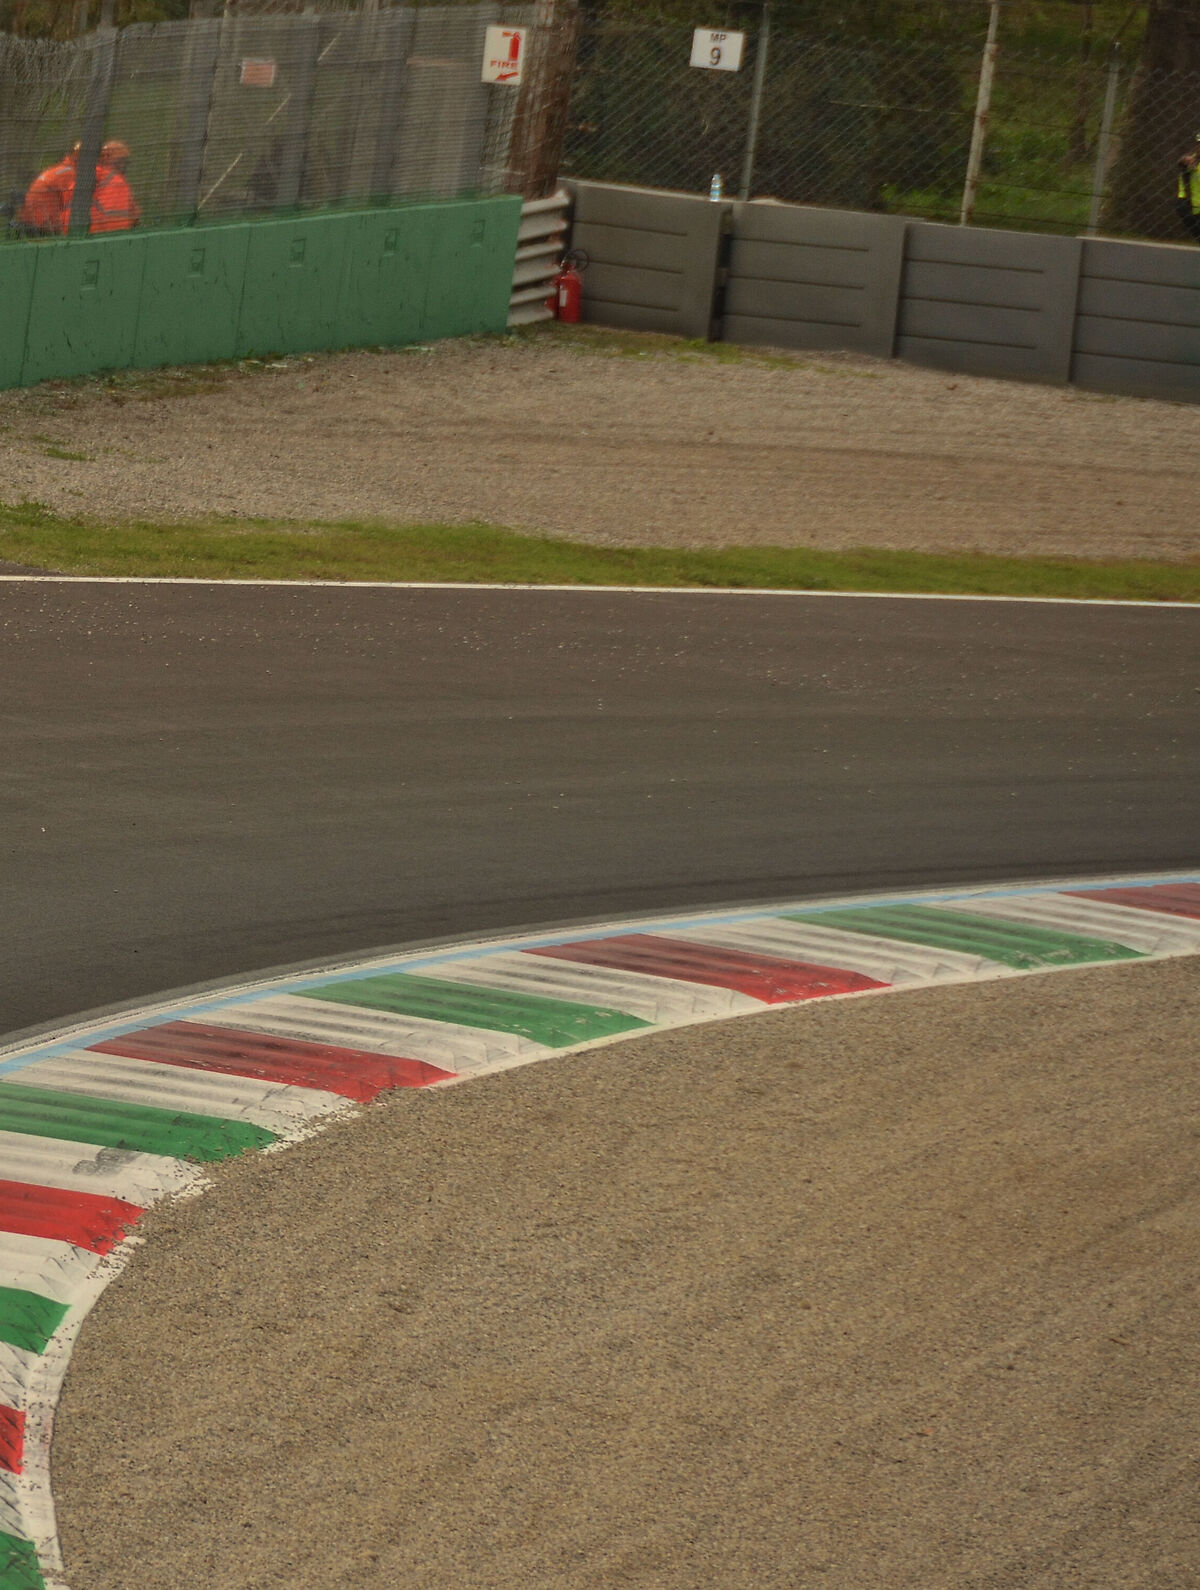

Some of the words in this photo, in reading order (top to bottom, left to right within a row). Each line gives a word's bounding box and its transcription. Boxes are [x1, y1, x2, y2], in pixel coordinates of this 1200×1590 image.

[710, 33, 727, 43] MP
[709, 47, 721, 66] 9
[490, 60, 518, 69] FIRE
